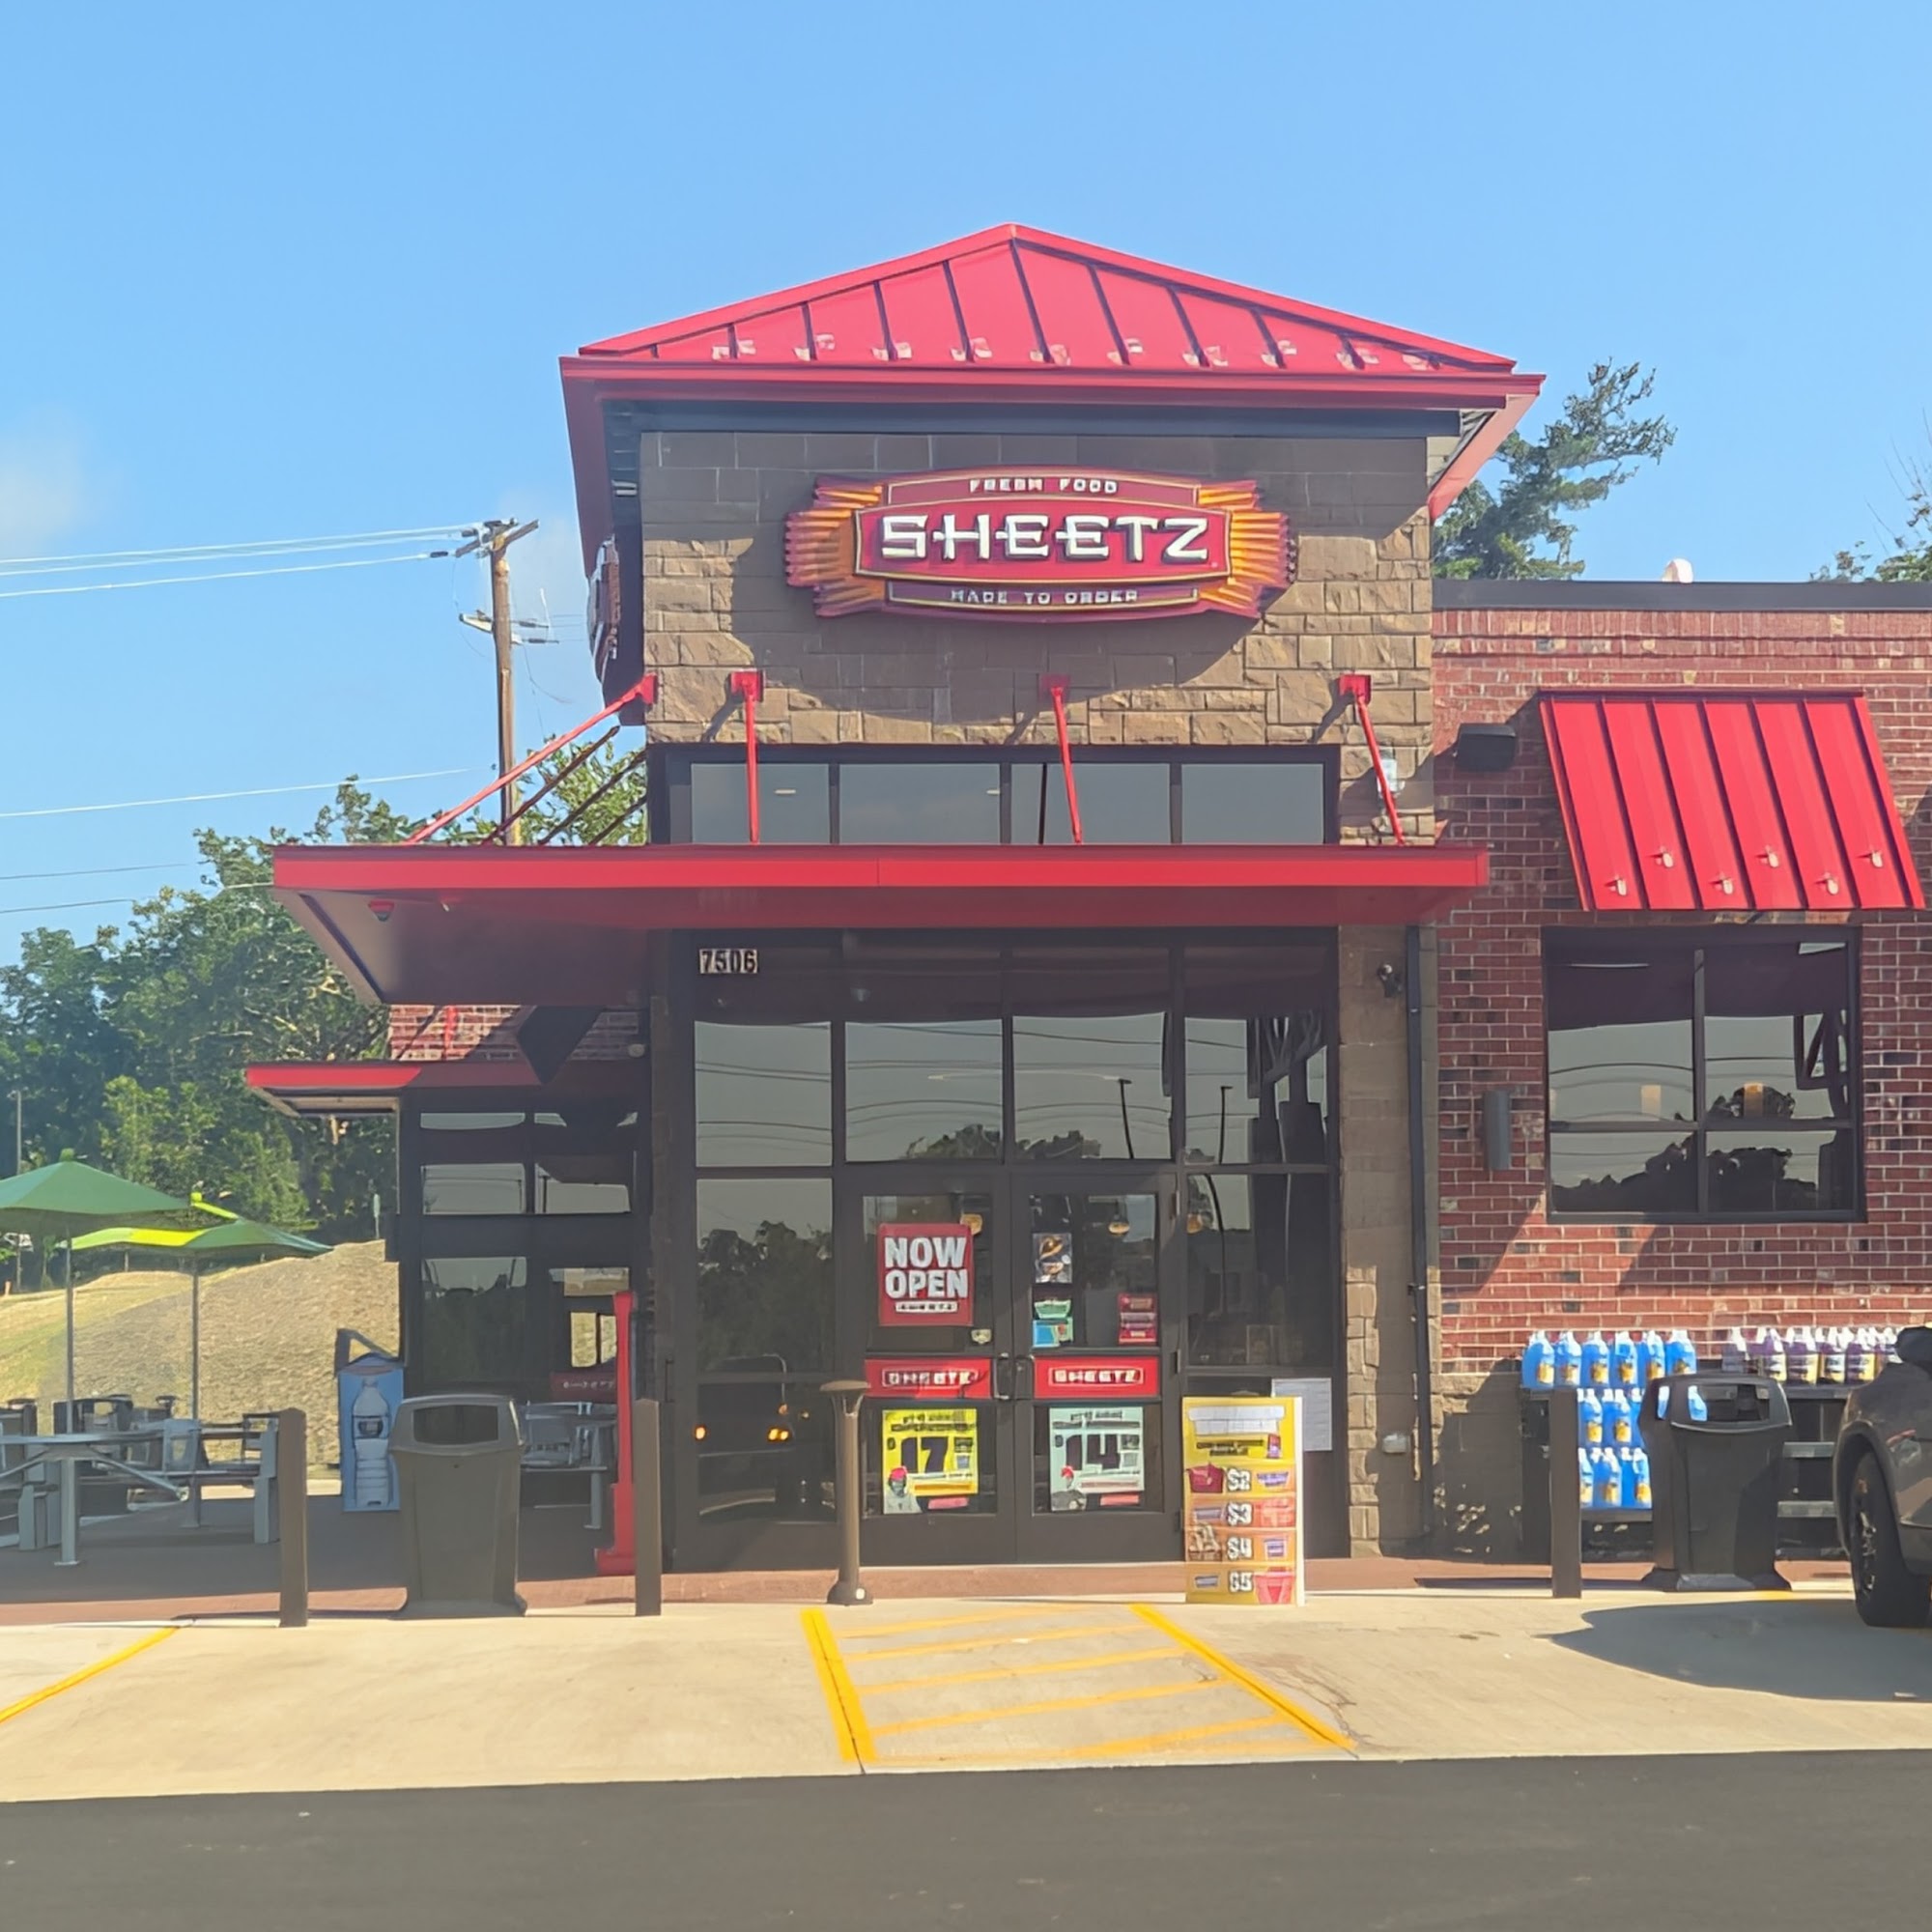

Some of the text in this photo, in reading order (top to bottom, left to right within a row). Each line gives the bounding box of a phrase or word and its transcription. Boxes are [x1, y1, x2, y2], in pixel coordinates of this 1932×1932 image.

[1059, 477, 1118, 494] FOOD
[881, 513, 1208, 562] SHEETZ
[950, 589, 1138, 605] MADE TO ORDER
[700, 950, 756, 973] 7506
[884, 1236, 967, 1268] NOW
[885, 1268, 969, 1299] OPEN
